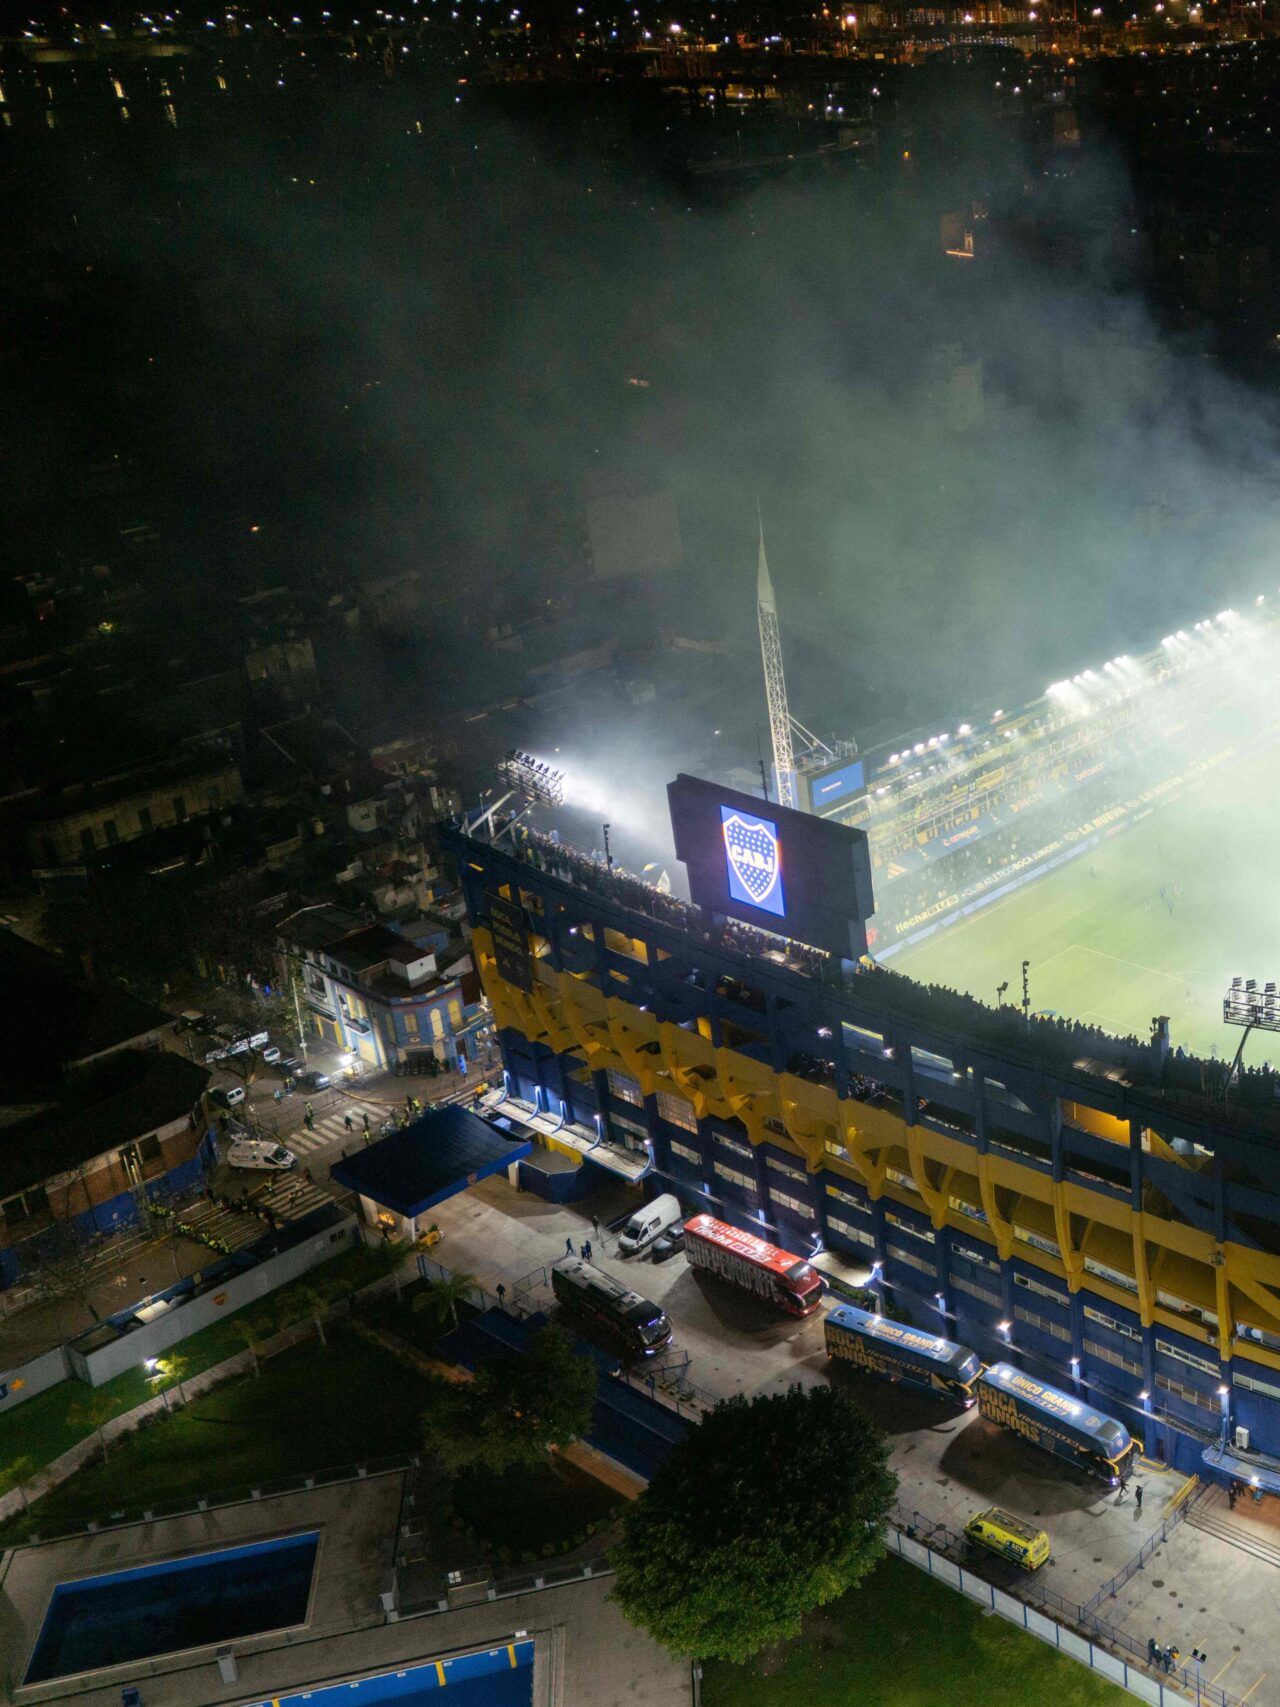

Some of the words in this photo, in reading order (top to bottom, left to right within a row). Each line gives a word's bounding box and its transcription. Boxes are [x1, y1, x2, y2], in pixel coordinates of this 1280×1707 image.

[902, 1333, 939, 1351] GRAND
[978, 1381, 1018, 1416] BOCA
[981, 1400, 1041, 1442] JUNIORS
